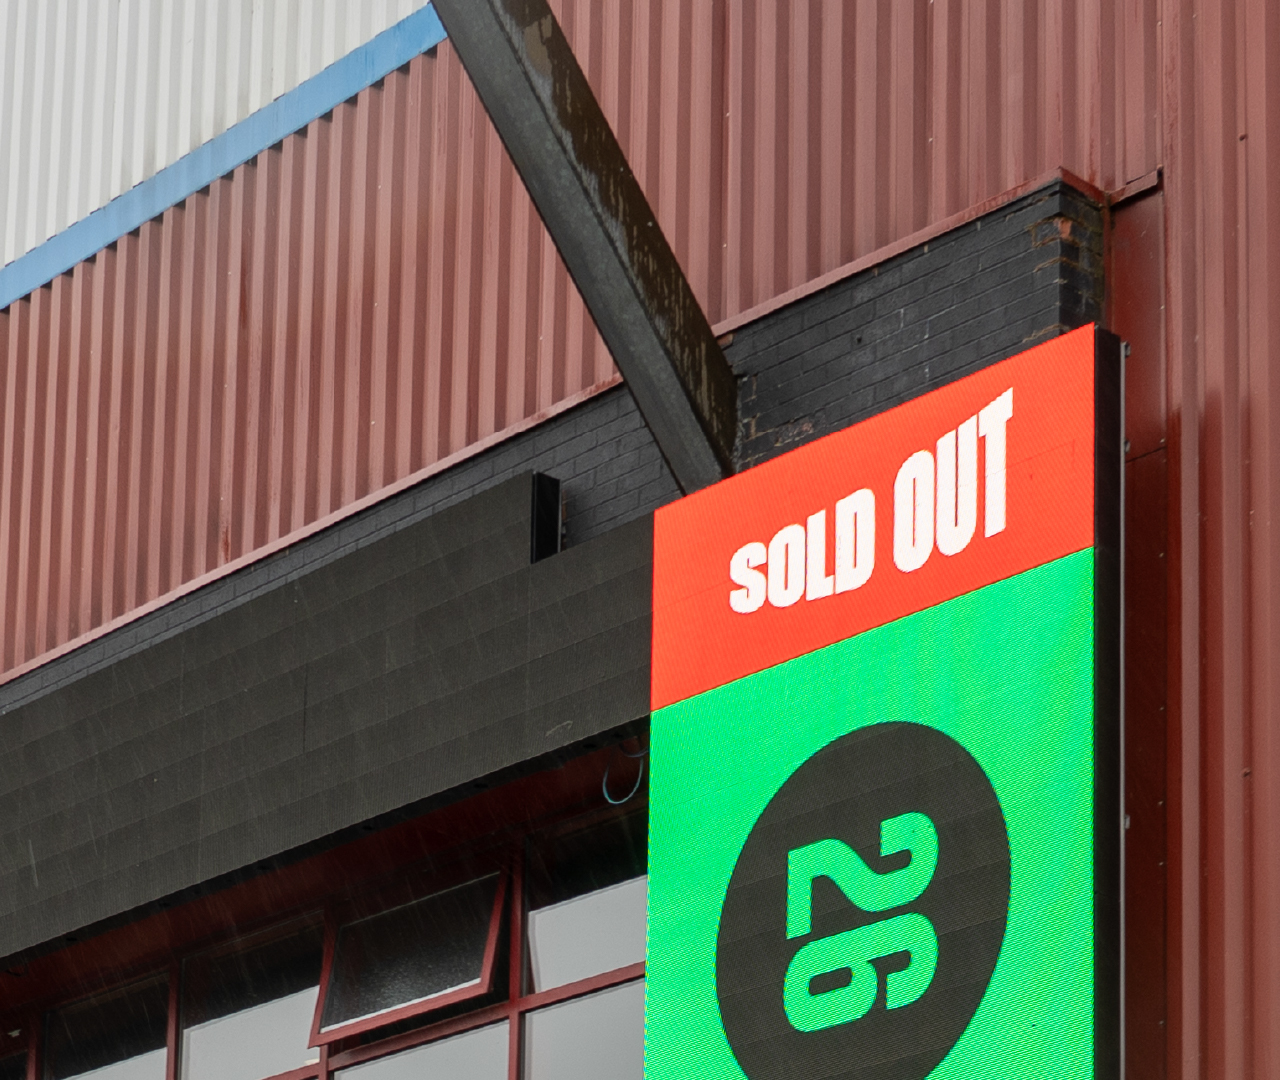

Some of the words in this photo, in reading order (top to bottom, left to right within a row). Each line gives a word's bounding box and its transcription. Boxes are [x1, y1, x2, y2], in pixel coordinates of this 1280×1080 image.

[730, 488, 876, 614] SOLD
[893, 387, 1013, 573] OUT
[783, 811, 939, 1034] 26
